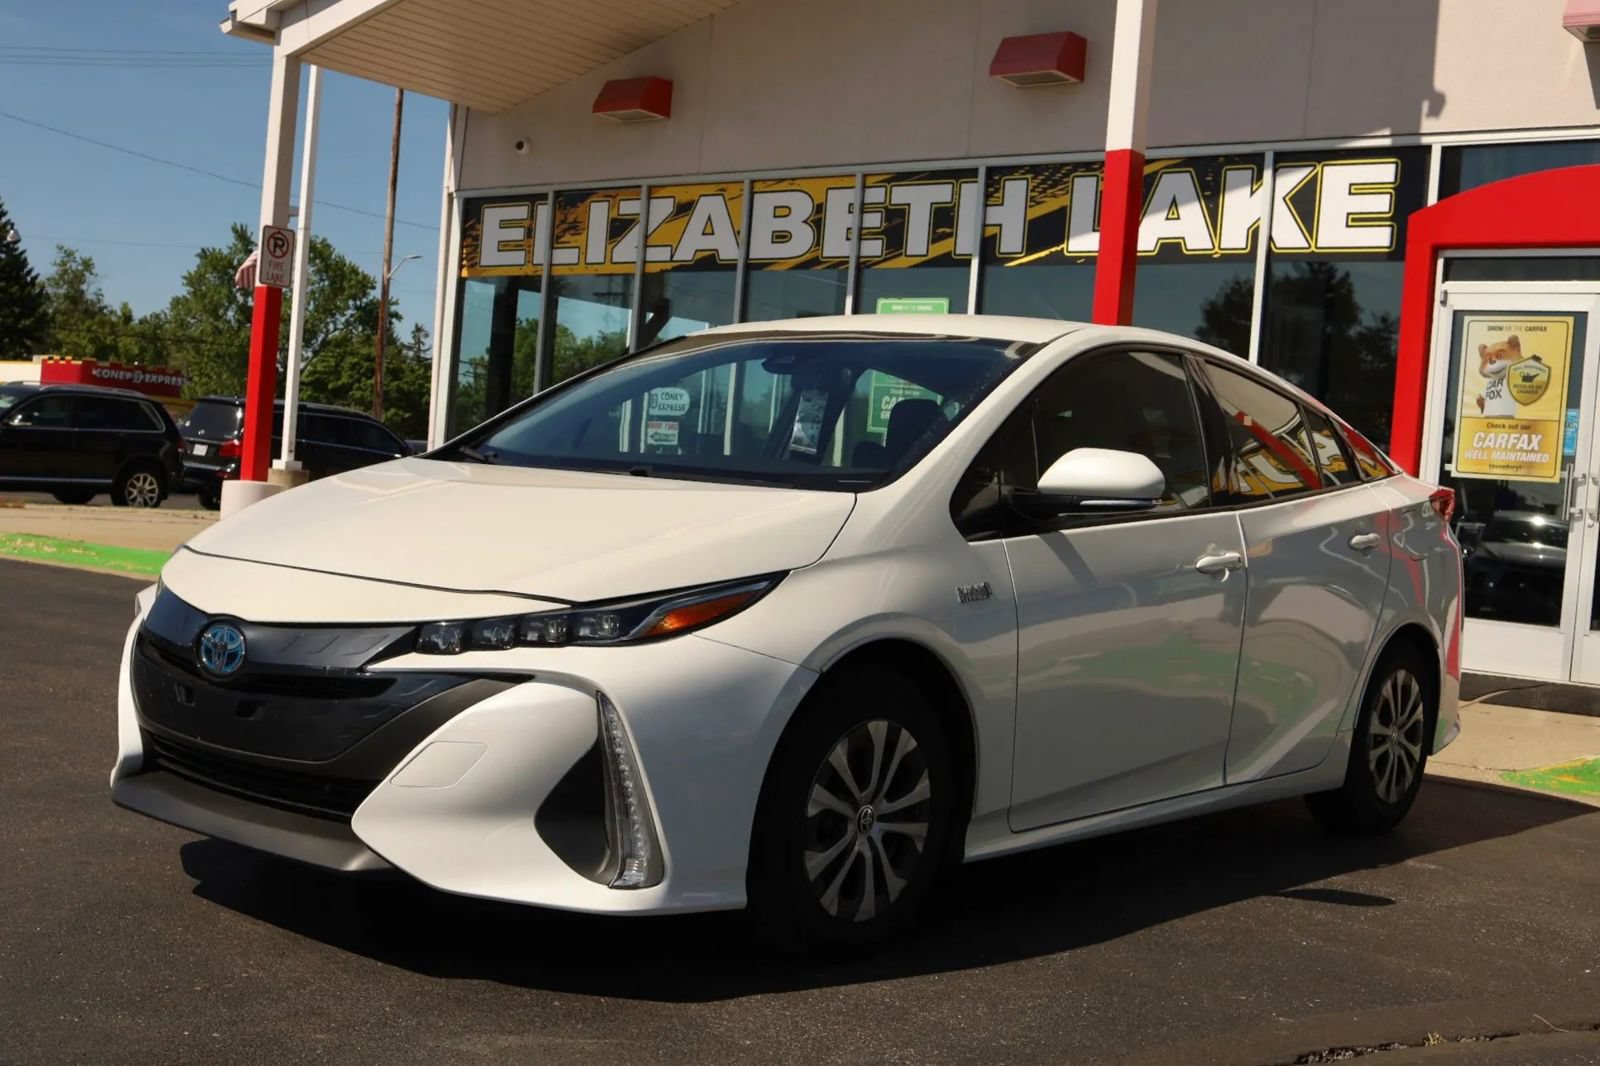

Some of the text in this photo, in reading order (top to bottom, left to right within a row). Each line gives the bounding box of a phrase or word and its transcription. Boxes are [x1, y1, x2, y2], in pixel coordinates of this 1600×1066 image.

[479, 158, 1400, 267] ELIZABETH LAKE
[265, 271, 287, 284] LANE
[96, 368, 132, 380] CONEY
[660, 391, 684, 401] CONEY
[1486, 389, 1502, 400] FOX
[658, 403, 686, 412] EXPRESS
[1472, 431, 1542, 450] CARFAX
[1465, 449, 1549, 463] WELL MAINTAINED
